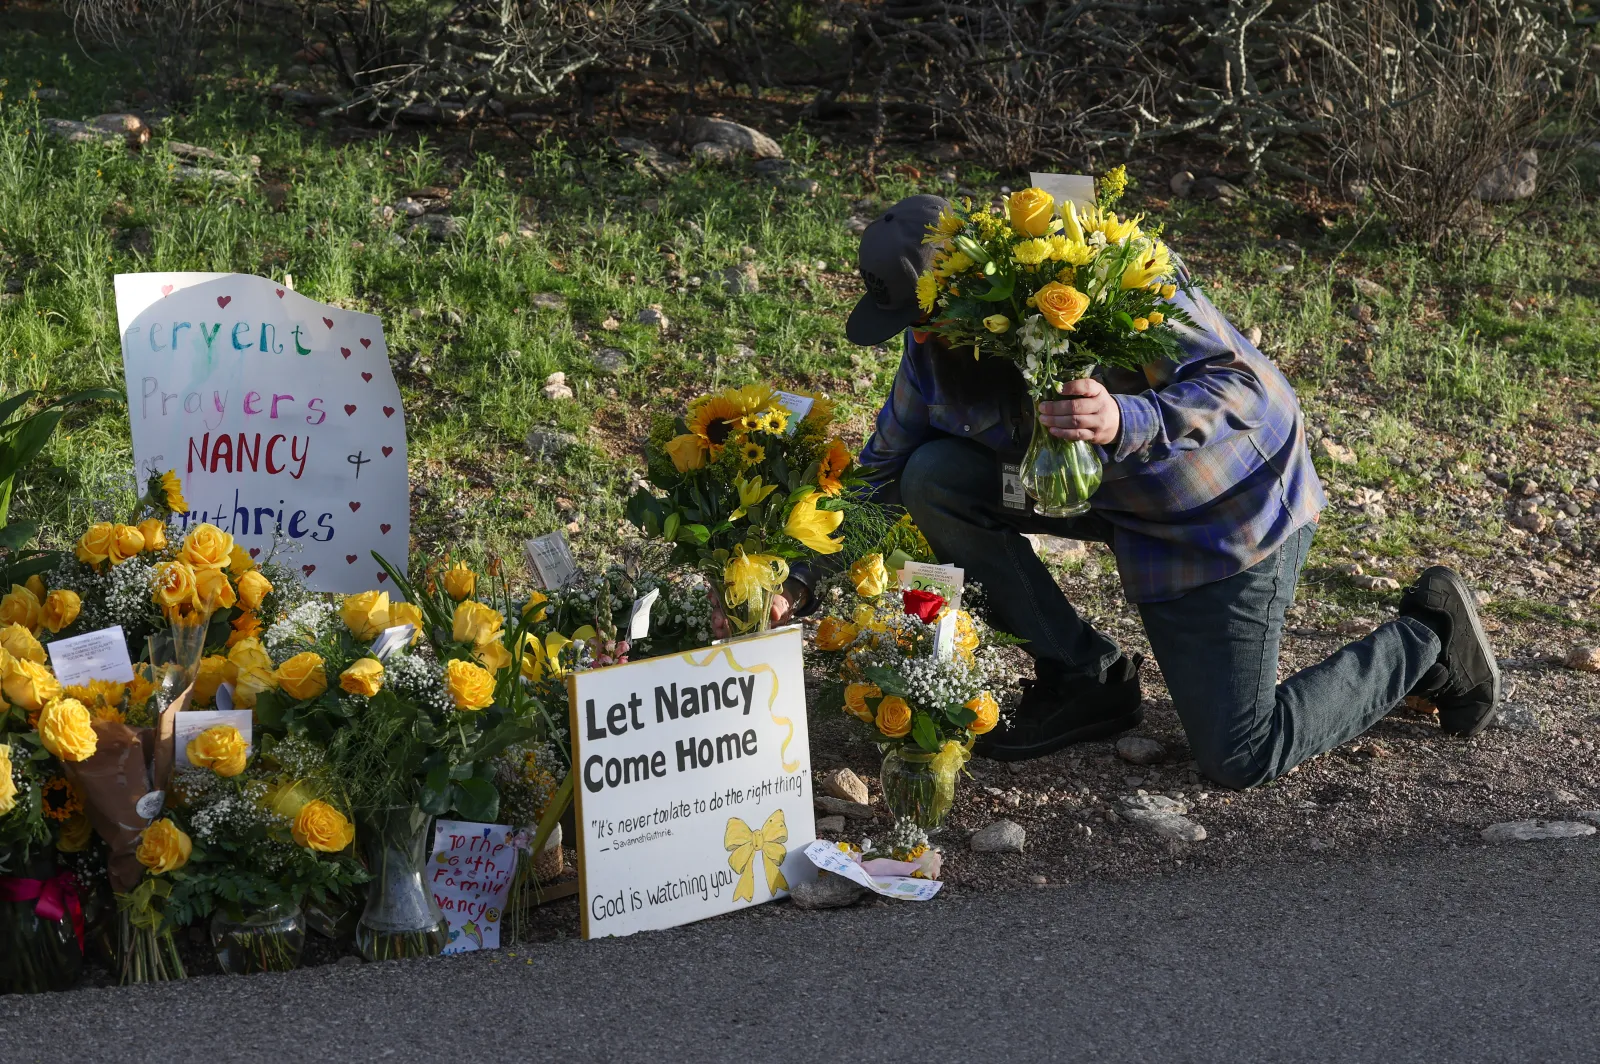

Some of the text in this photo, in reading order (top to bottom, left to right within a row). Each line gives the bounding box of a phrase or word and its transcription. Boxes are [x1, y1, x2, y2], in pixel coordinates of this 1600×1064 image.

[141, 376, 327, 431] Prayers
[136, 452, 164, 479] or
[187, 432, 310, 480] NANCY
[1004, 464, 1020, 473] PRES
[166, 489, 335, 542] uthries
[586, 674, 755, 741] Let Nancy
[583, 728, 758, 793] Come Home
[617, 813, 651, 834] never
[694, 798, 707, 815] to
[709, 790, 724, 809] do
[724, 788, 744, 807] the
[746, 782, 772, 805] right
[774, 770, 808, 798] thing"
[470, 835, 504, 856] The
[612, 834, 647, 851] Savannah
[434, 893, 488, 922] Nancy
[592, 868, 733, 921] God is watching you
